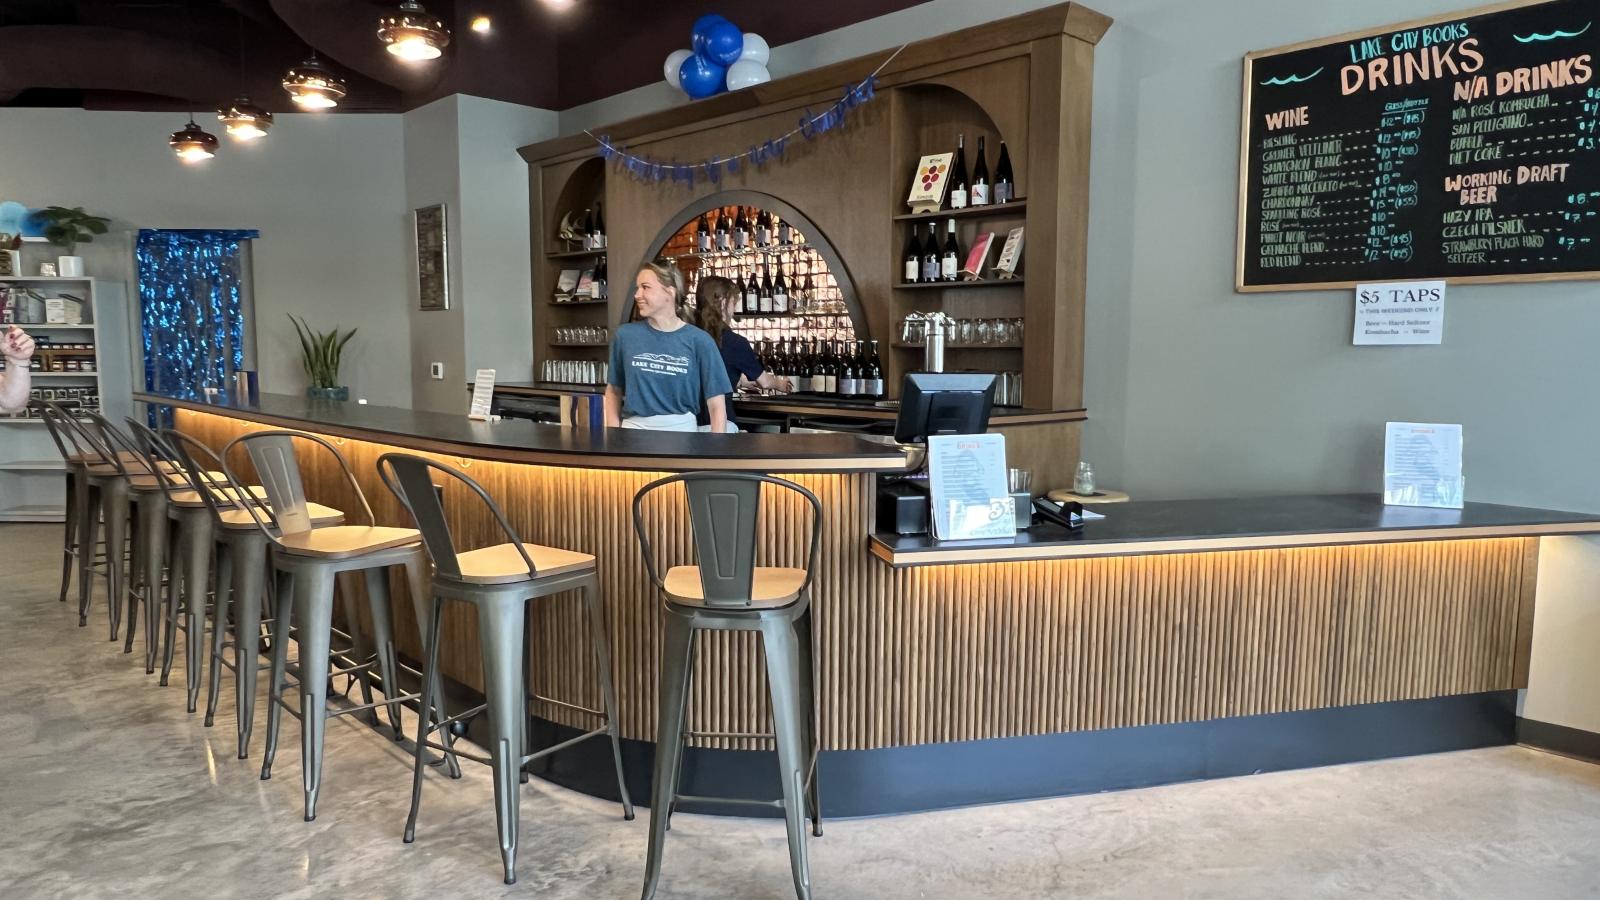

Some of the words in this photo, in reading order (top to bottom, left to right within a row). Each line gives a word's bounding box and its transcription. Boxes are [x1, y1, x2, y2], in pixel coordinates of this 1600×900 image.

[1350, 36, 1386, 63] LAKE
[1392, 31, 1418, 52] CITY
[1423, 22, 1469, 48] BOOKS
[1340, 37, 1484, 96] DRINKS
[1453, 75, 1488, 103] N/A
[1496, 54, 1593, 96] DRINKS
[1265, 106, 1309, 131] WINE
[1474, 145, 1503, 162] COKE
[1445, 169, 1512, 192] WORKING
[1517, 163, 1570, 185] DRAFT
[1460, 186, 1498, 206] BEER
[1475, 208, 1494, 221] IPA
[1442, 222, 1479, 237] CZECH
[1360, 289, 1380, 306] $5
[1389, 288, 1441, 303] TAPS
